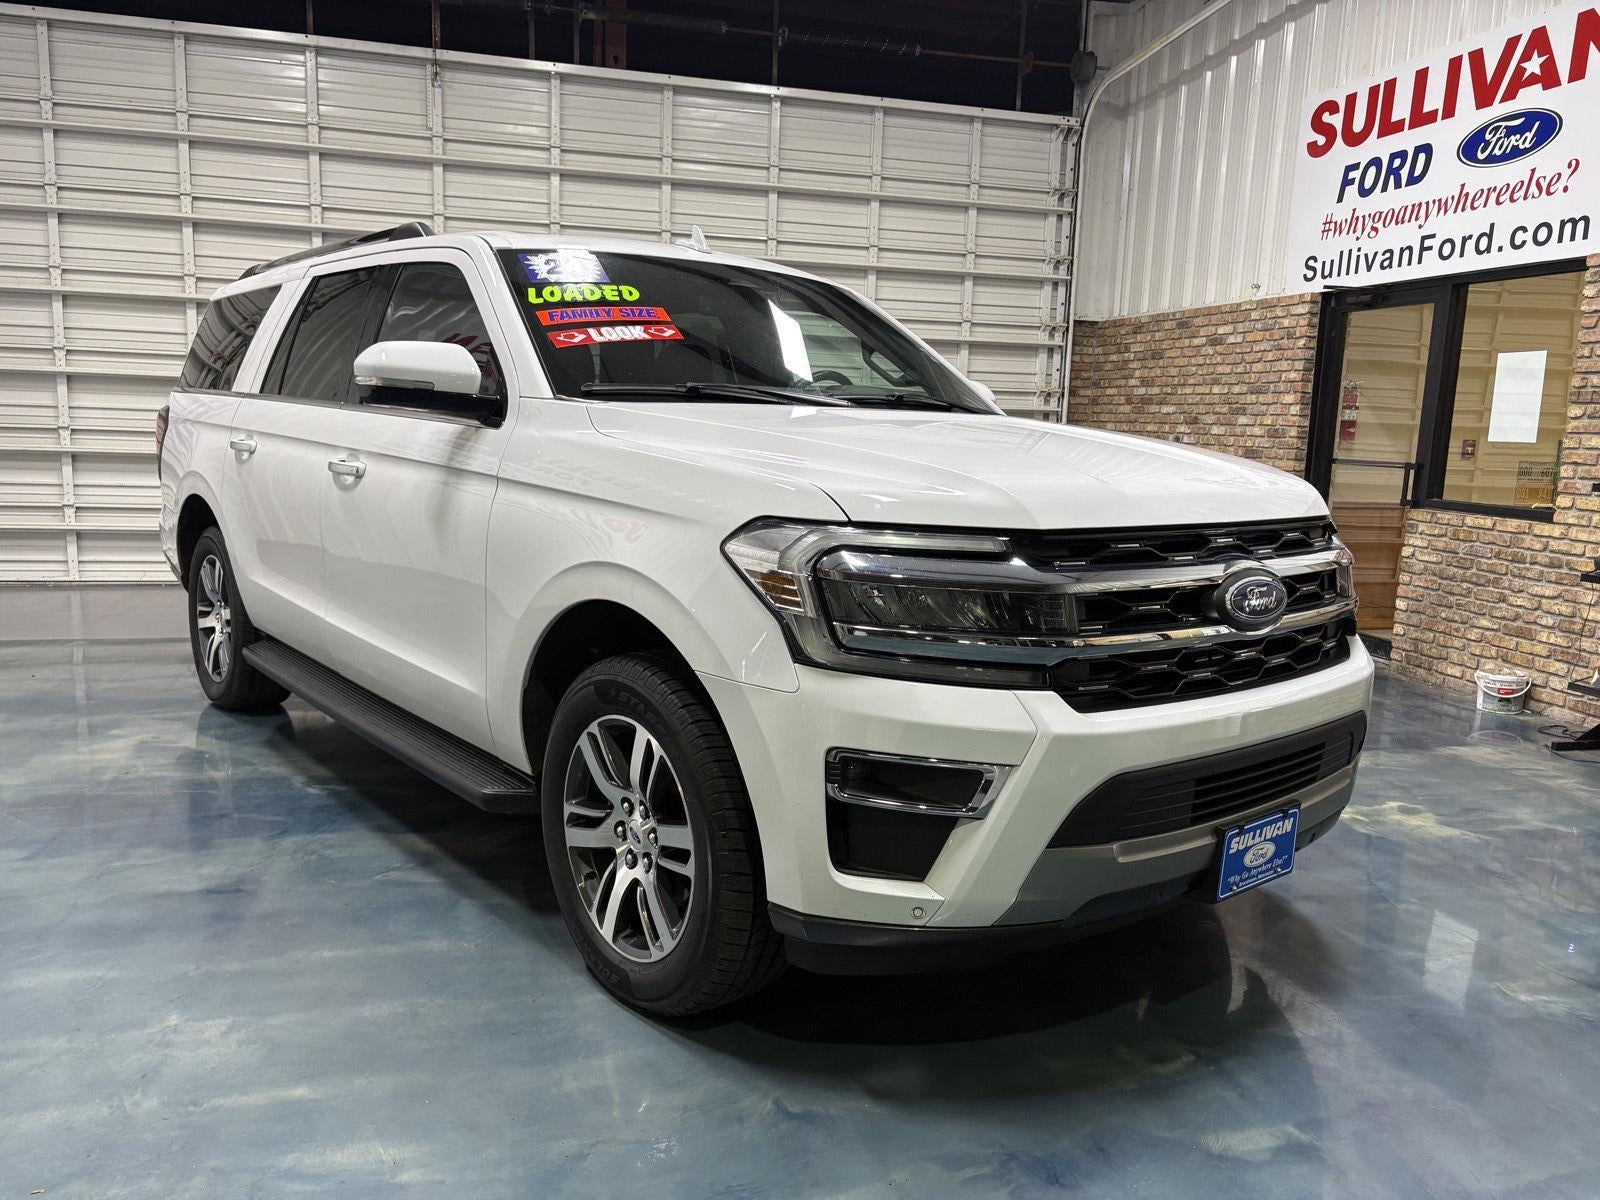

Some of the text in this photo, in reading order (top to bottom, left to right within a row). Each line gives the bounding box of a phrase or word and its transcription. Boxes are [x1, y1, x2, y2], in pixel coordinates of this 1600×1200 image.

[1477, 116, 1541, 160] Ford
[1336, 142, 1433, 203] FORD
[1321, 158, 1580, 241] #whygoanywhereelse?
[1303, 214, 1591, 282] SullivanFord.com
[528, 285, 640, 304] LOADED
[548, 307, 659, 322] FAMILY SIZE
[587, 325, 649, 342] LOOK
[1243, 586, 1277, 613] Ford
[1229, 817, 1294, 854] SULLIVAN
[1249, 846, 1269, 864] Ford
